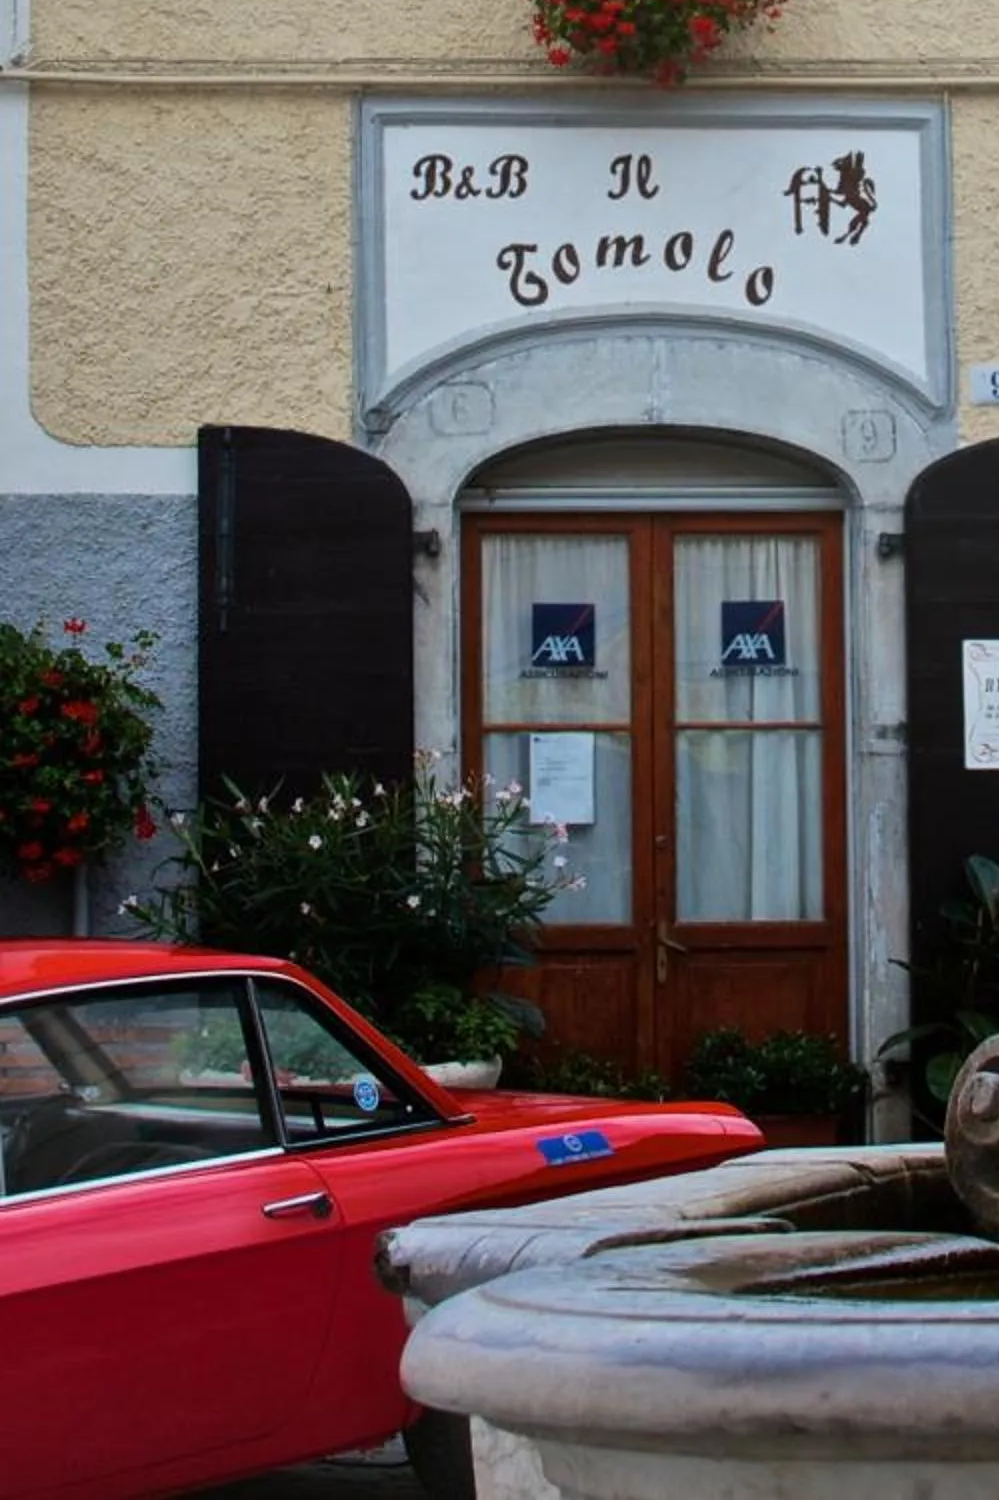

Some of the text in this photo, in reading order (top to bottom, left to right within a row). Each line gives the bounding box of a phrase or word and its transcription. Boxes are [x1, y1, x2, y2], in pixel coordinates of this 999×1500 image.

[411, 153, 660, 200] B&B Il
[496, 229, 774, 306] Tomolo
[531, 635, 584, 661] AXA
[722, 633, 774, 659] AXA
